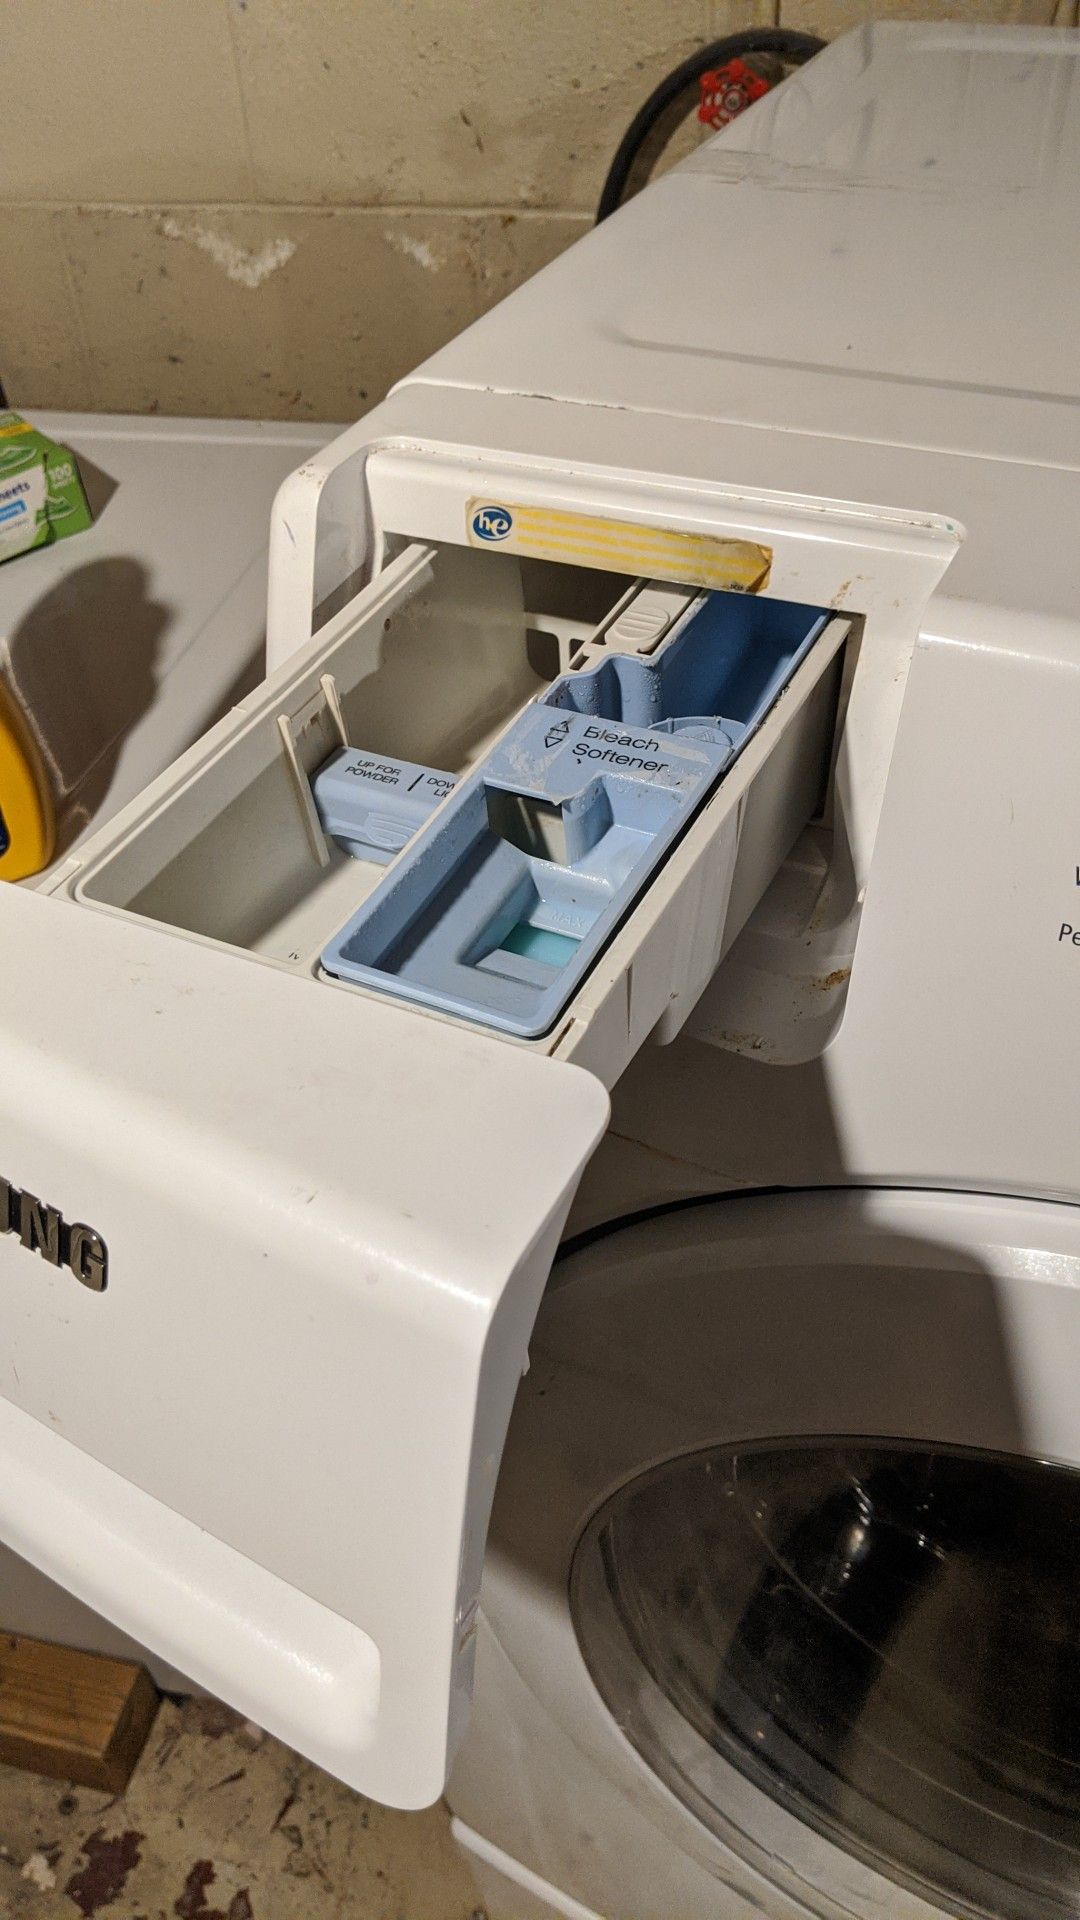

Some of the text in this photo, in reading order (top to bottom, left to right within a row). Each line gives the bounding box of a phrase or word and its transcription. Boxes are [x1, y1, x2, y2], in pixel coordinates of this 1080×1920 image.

[478, 510, 510, 538] he
[584, 726, 660, 752] Bleach
[572, 743, 669, 773] Softener
[345, 766, 399, 785] POWDER
[0, 1175, 108, 1292] NG
